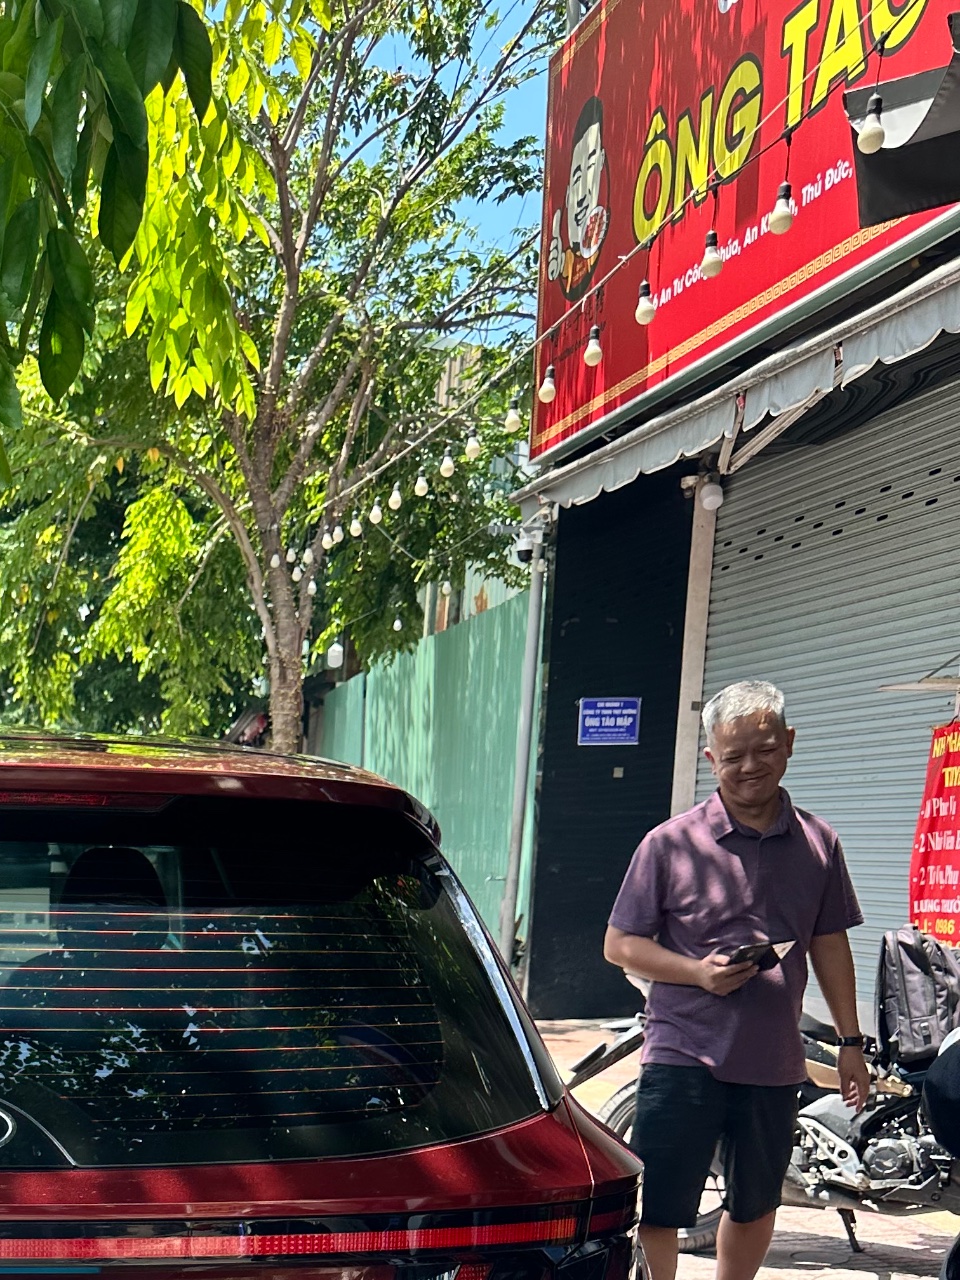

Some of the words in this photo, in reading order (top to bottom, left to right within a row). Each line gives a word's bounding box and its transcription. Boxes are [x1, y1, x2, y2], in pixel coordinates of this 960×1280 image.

[633, 53, 763, 246] ÔNG
[717, 238, 741, 262] húa,
[743, 225, 758, 248] An
[801, 173, 821, 207] Thủ
